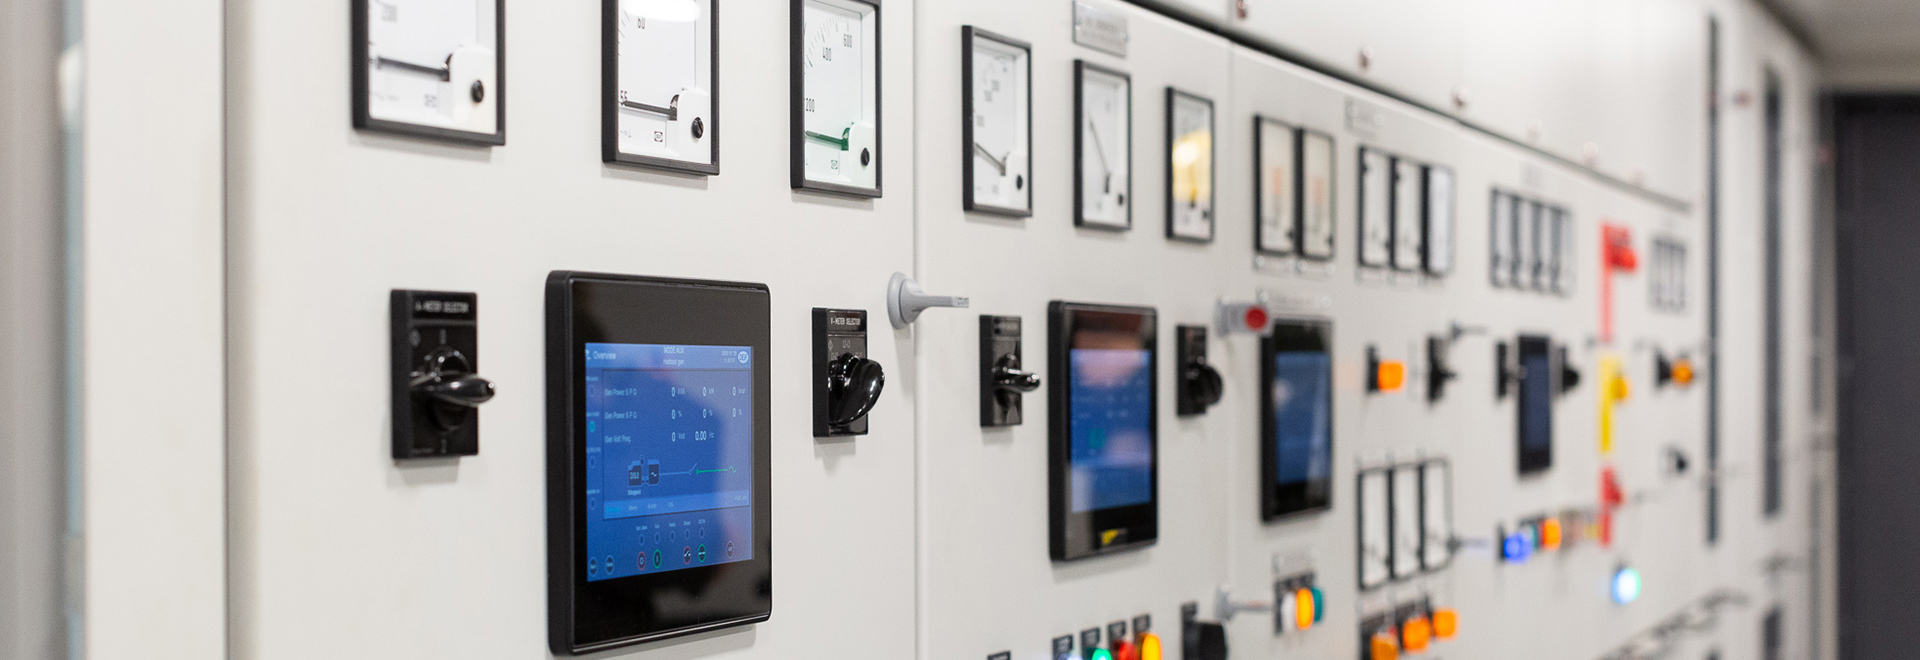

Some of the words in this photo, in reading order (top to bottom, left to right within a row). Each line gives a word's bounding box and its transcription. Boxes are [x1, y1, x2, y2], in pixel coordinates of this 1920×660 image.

[843, 33, 853, 48] 600
[822, 46, 832, 62] 400
[805, 97, 815, 112] 200
[846, 317, 860, 326] SELECTOR
[593, 351, 617, 360] Overview
[694, 430, 707, 441] 0.00
